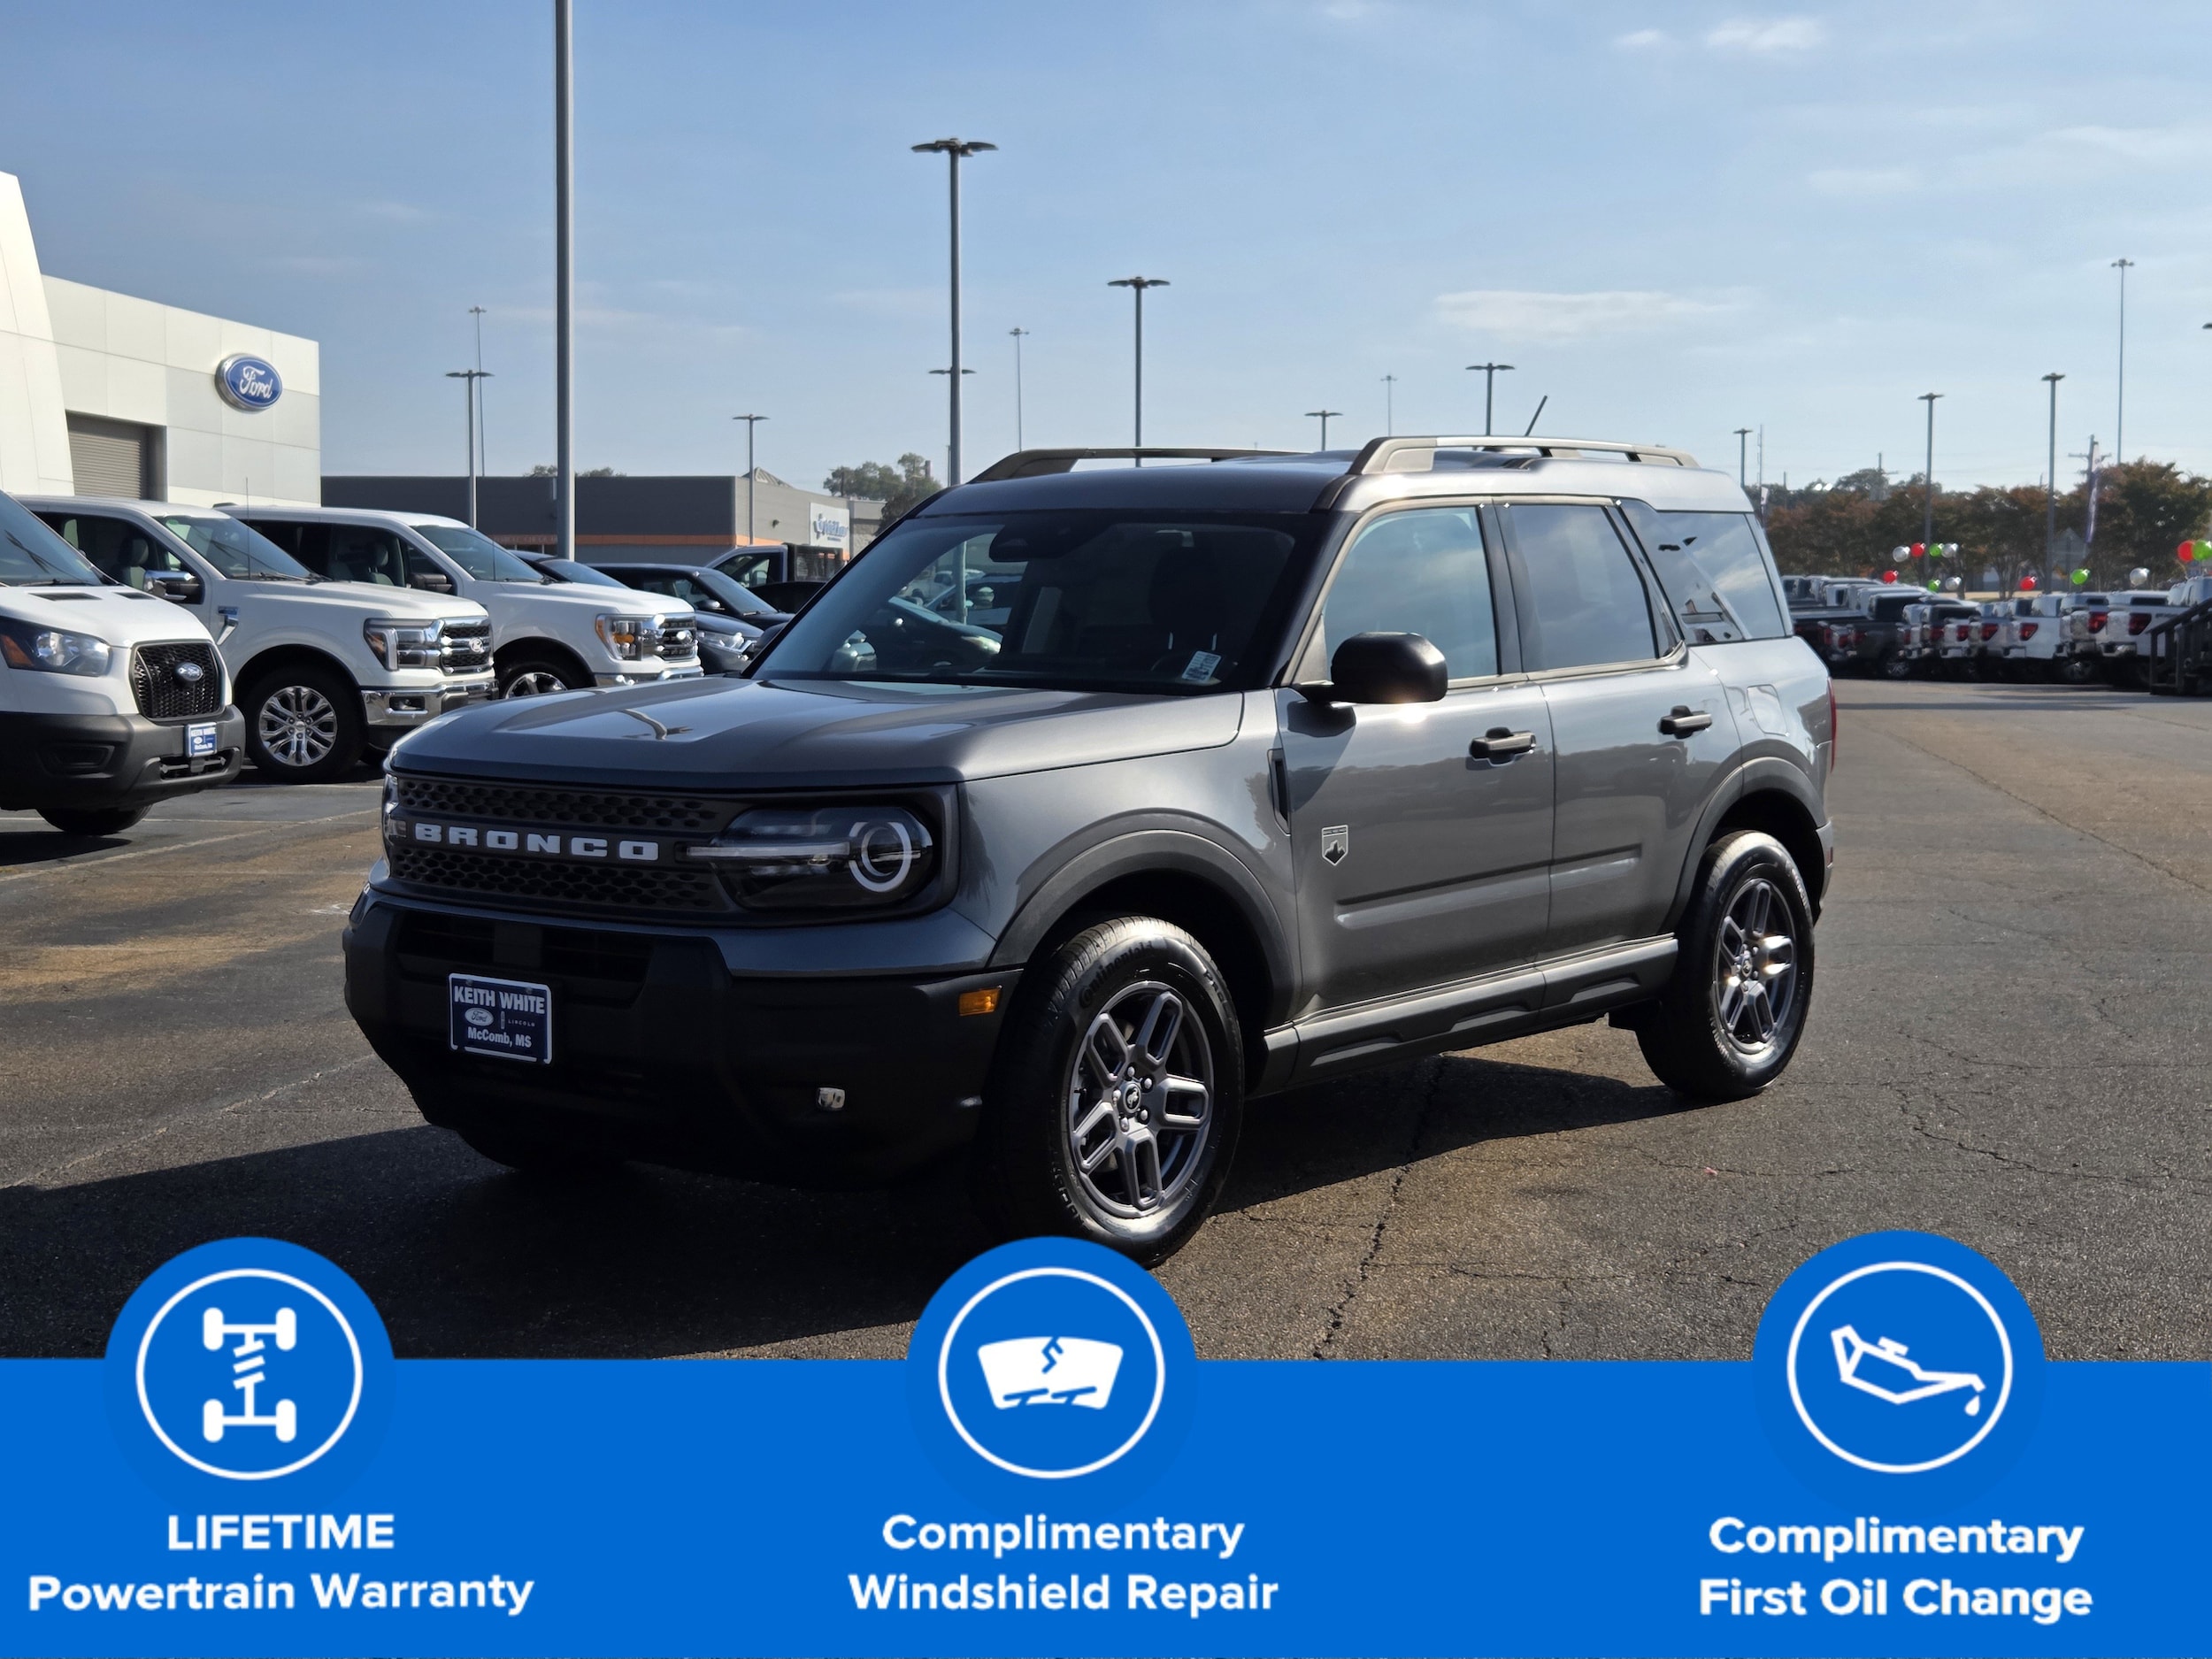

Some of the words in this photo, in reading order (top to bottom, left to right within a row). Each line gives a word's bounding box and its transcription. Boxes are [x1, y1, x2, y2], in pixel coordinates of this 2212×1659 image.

[240, 365, 273, 399] Ford
[415, 823, 658, 860] BRONCO
[454, 986, 495, 1007] KEITH
[499, 992, 545, 1014] WHITE
[467, 1026, 513, 1048] McComb,
[515, 1033, 533, 1048] MS
